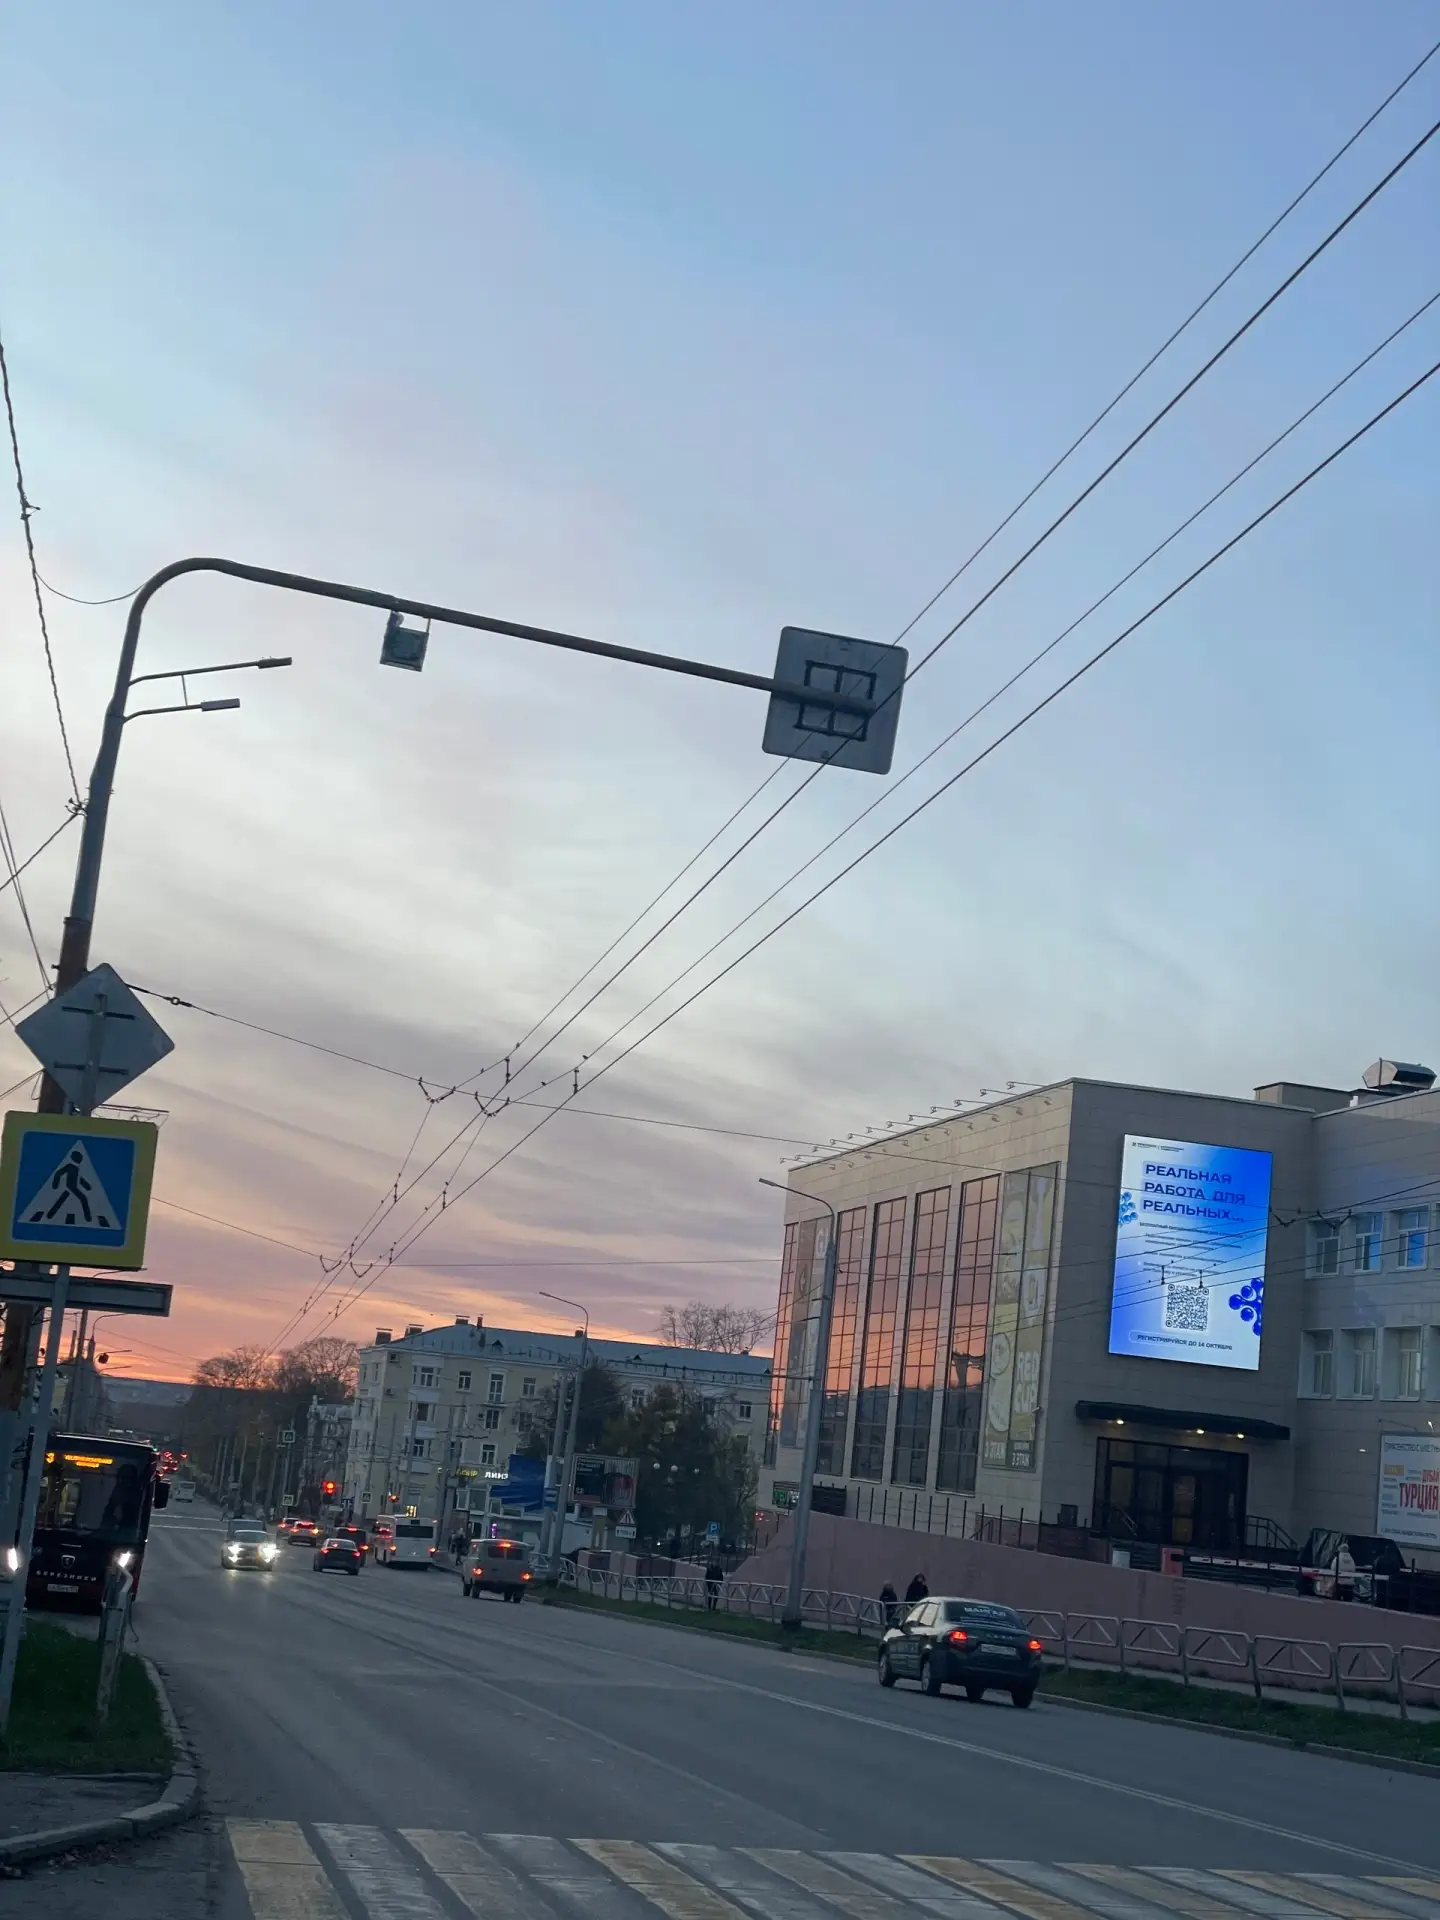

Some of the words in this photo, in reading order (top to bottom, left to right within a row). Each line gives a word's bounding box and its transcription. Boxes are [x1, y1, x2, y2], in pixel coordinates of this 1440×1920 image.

[1146, 1165, 1232, 1184] РЕАЛЬНАЯ
[1144, 1181, 1205, 1200] РАБОТА
[1213, 1190, 1245, 1205] ДЛЯ
[1143, 1199, 1244, 1222] РЕАЛЬНЫХ...
[1137, 1334, 1187, 1345] РЕГИСТРИРУЙСЯ
[1206, 1342, 1233, 1350] ОКТЯБРЯ
[1016, 1350, 1040, 1382] RED
[1014, 1382, 1038, 1413] CUP
[1399, 1482, 1439, 1512] ТУРЦИЯ
